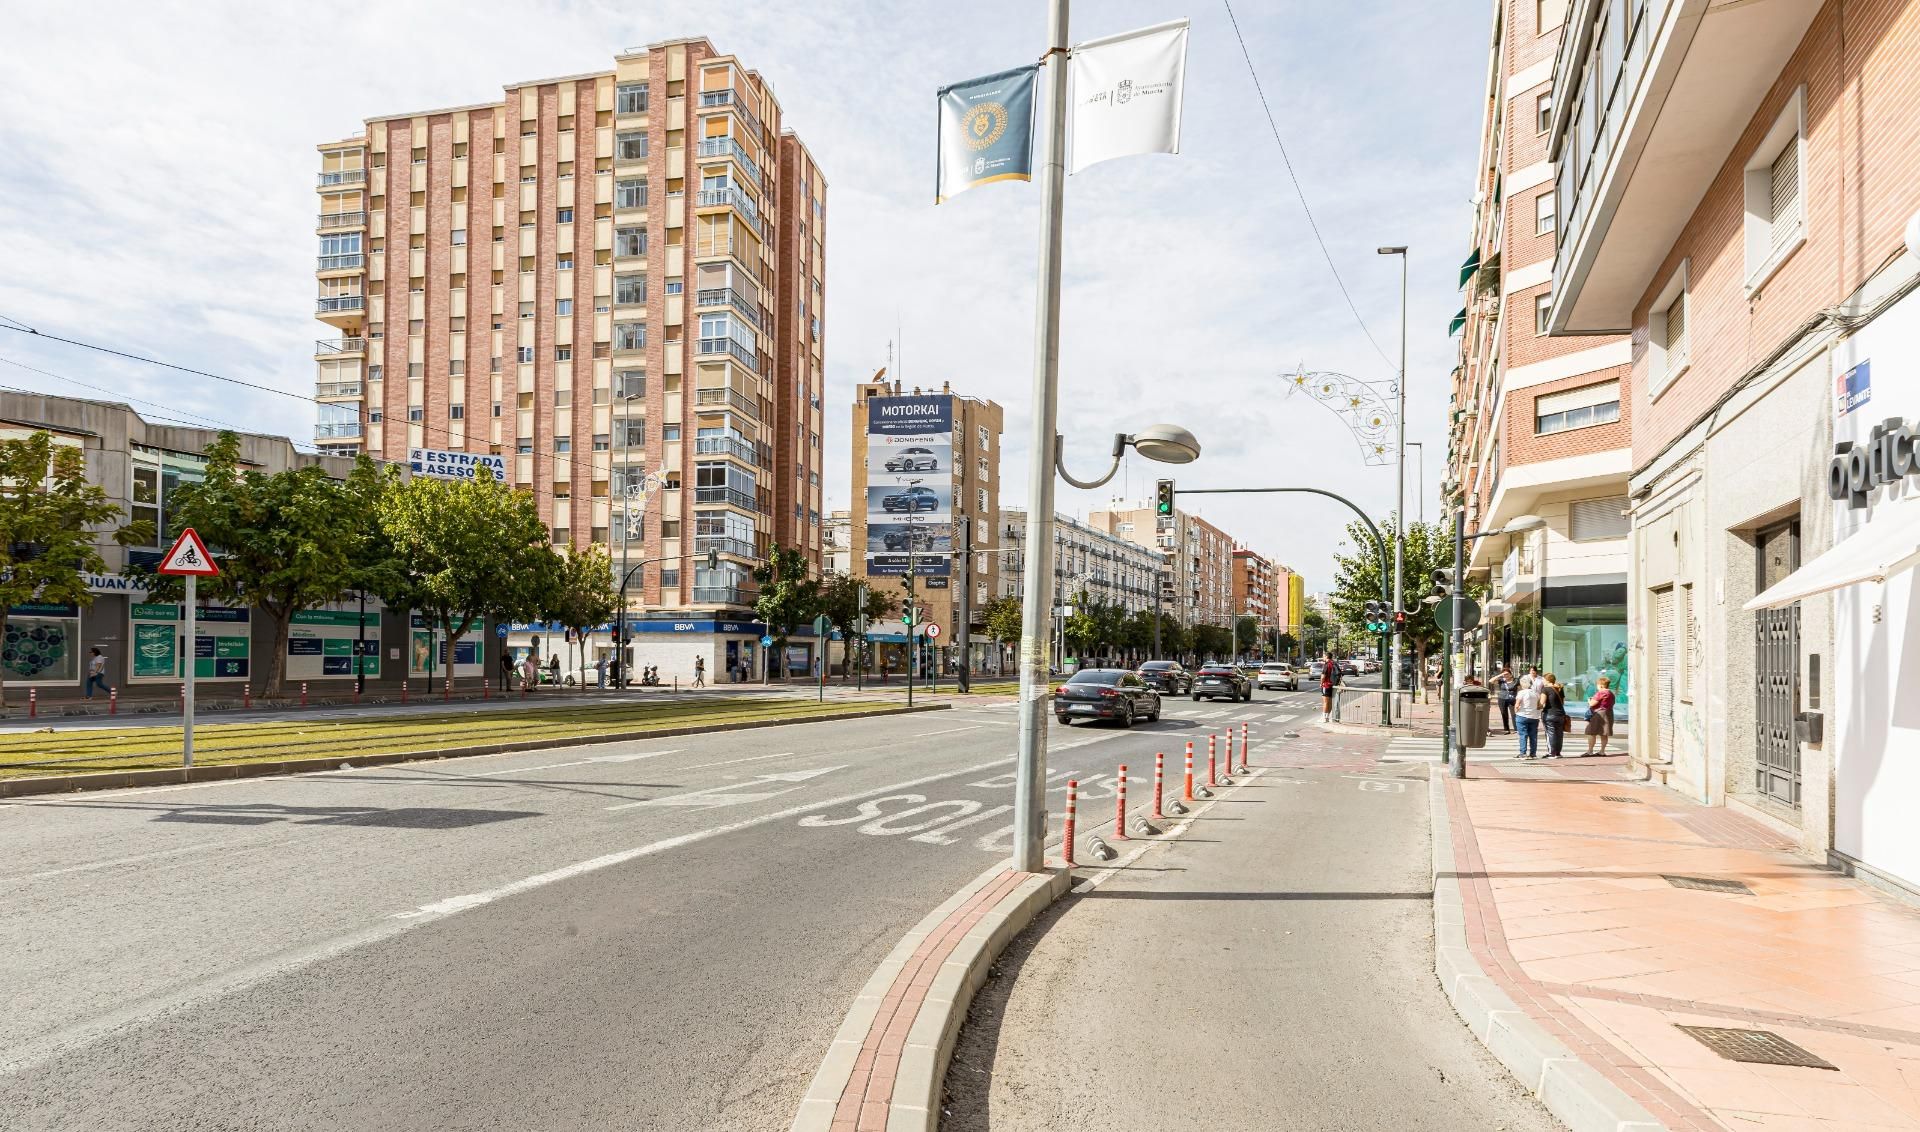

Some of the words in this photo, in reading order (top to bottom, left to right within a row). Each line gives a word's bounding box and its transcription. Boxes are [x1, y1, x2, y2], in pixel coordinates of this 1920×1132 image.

[881, 405, 939, 417] MOTORKAI
[427, 451, 504, 469] ESTRADA
[427, 464, 504, 480] ASESOS
[88, 577, 126, 590] JUAN
[511, 623, 529, 631] BBVA
[674, 623, 695, 631] BBVA
